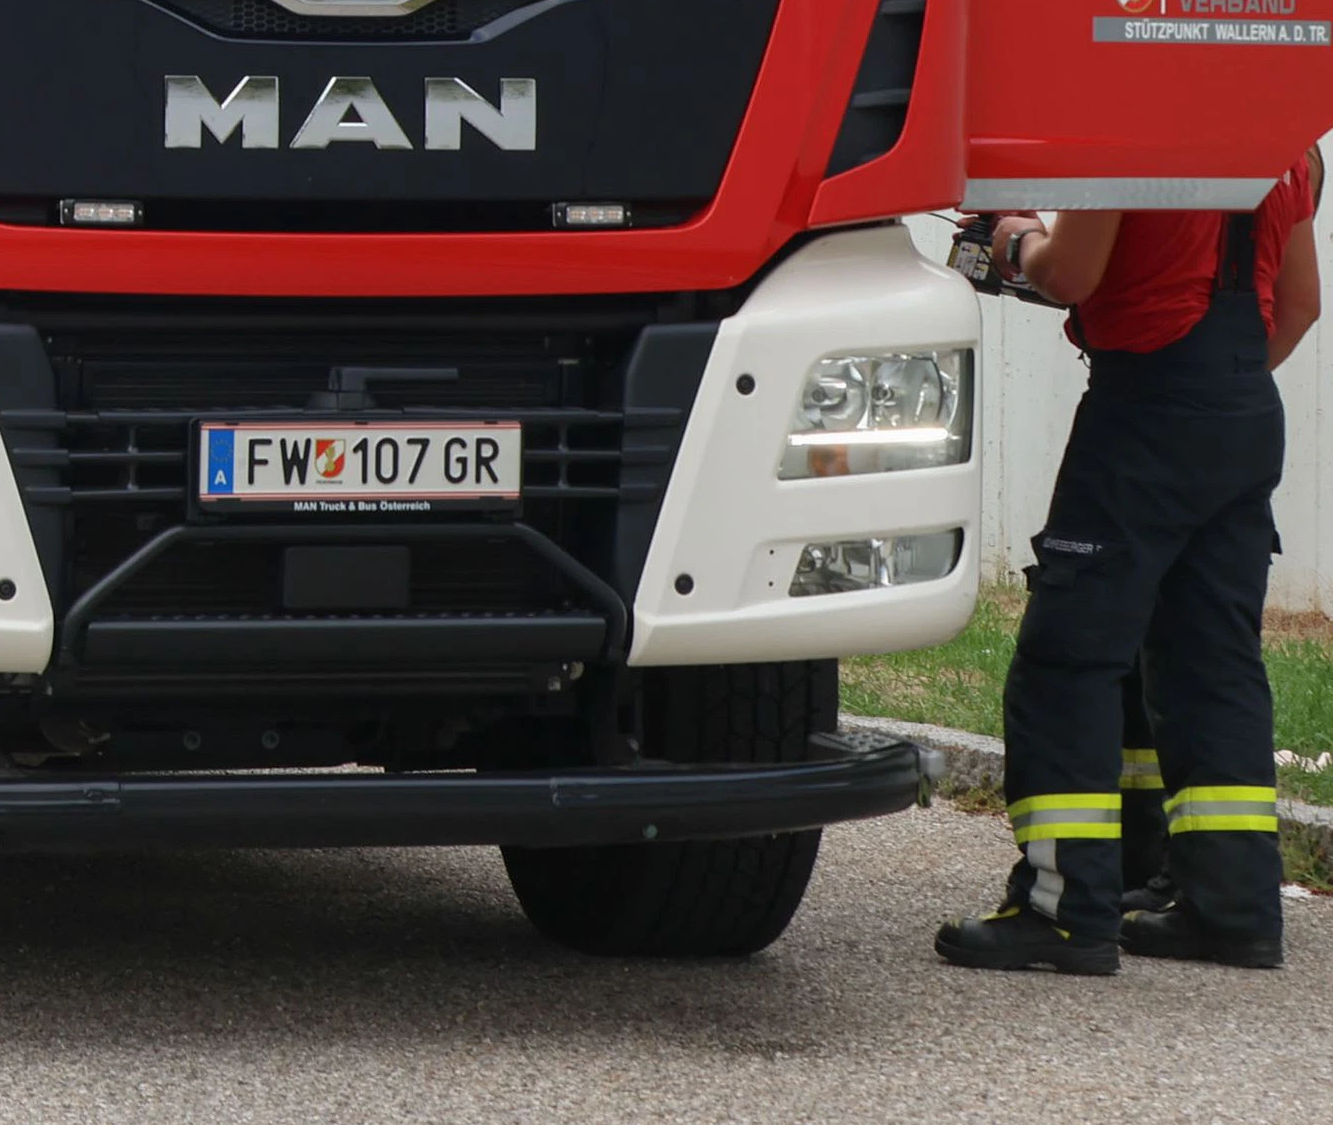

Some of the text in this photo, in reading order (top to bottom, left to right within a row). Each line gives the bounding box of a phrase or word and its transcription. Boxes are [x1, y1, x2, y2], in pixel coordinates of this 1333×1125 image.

[1125, 18, 1330, 42] STÜTZPUNKT WALLERN A. D. TR.
[164, 76, 536, 151] MAN
[248, 437, 500, 485] FW 107 GR
[214, 470, 227, 485] A
[294, 500, 431, 511] MAN Truck & Bus Österreich
